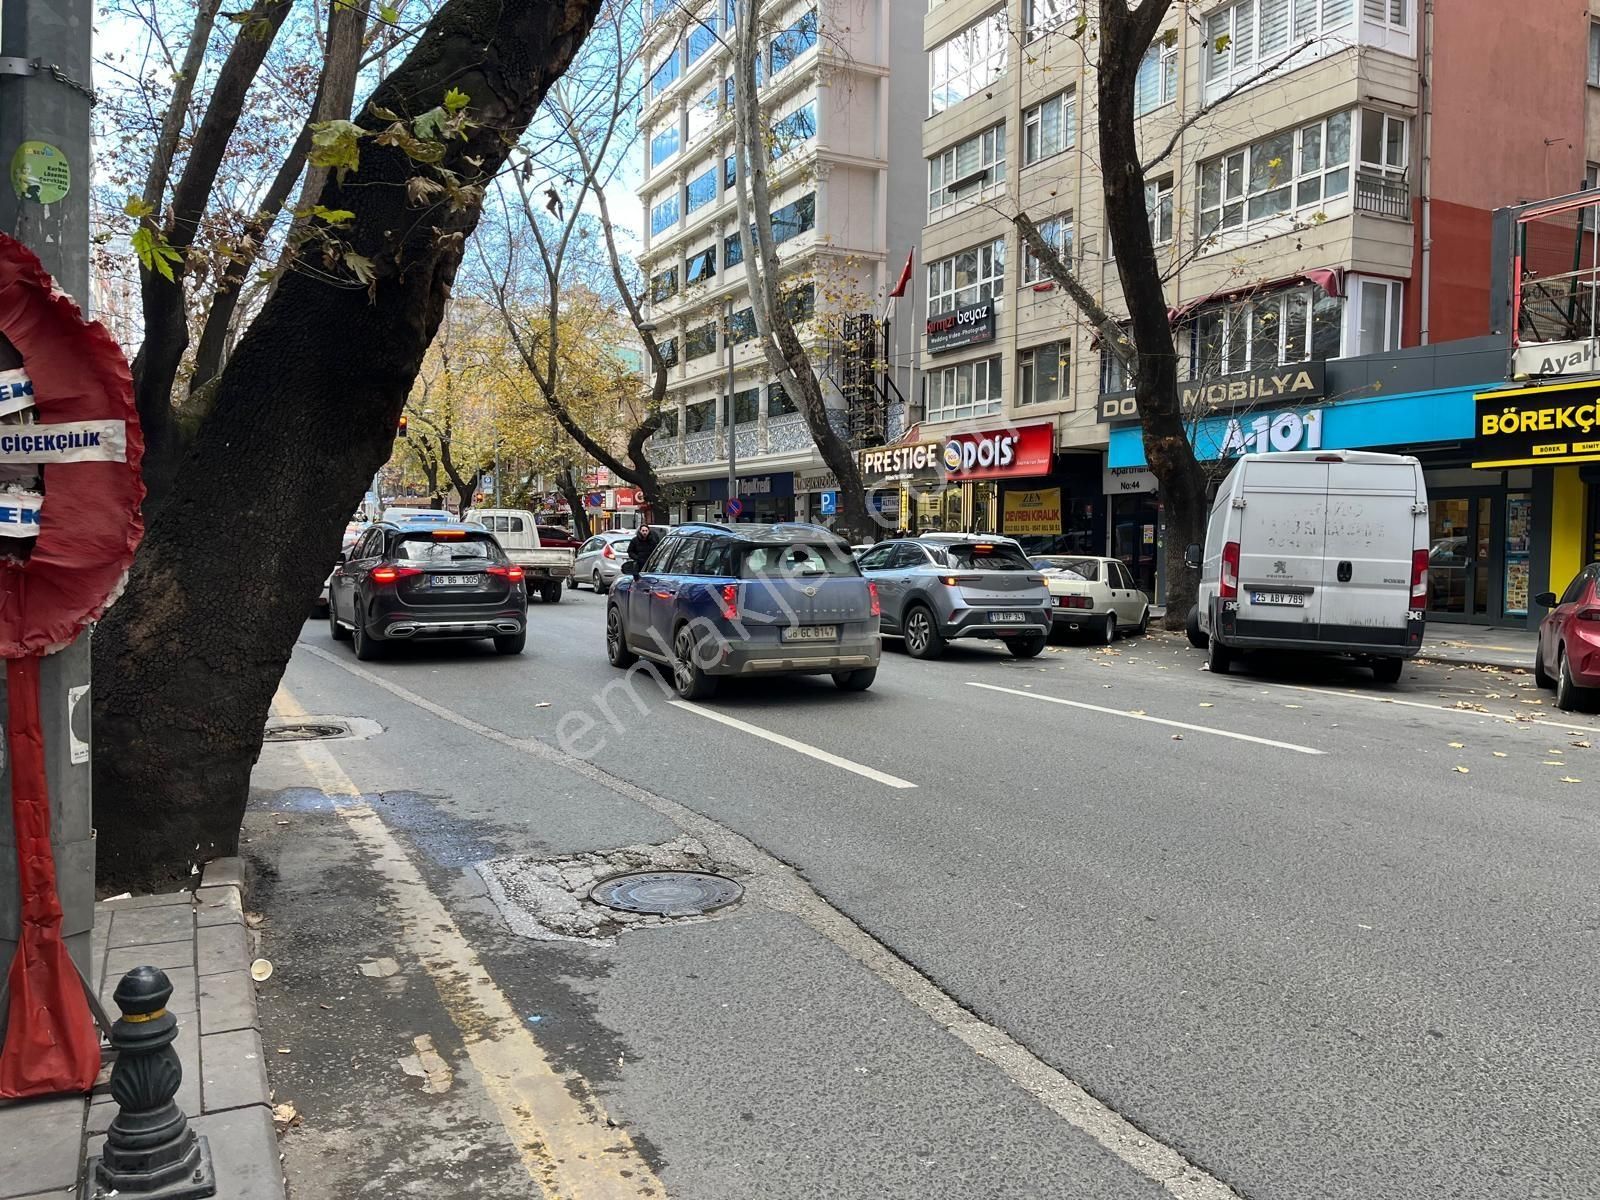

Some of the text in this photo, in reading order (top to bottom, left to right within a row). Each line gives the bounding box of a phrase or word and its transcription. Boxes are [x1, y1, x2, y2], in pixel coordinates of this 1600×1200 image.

[956, 305, 988, 326] beyaz
[1539, 344, 1600, 375] Ayak
[1102, 371, 1315, 418] DO MOBİLYA
[1482, 398, 1600, 436] BÖREKÇİ
[1, 431, 100, 454] ÇİÇEKÇİLİK
[864, 443, 937, 475] PRESTIGE
[1120, 481, 1140, 491] No:44
[1023, 493, 1041, 503] ZEN
[1005, 509, 1060, 521] DEVREN KIRALIK
[1256, 593, 1303, 604] 25 ABV 789
